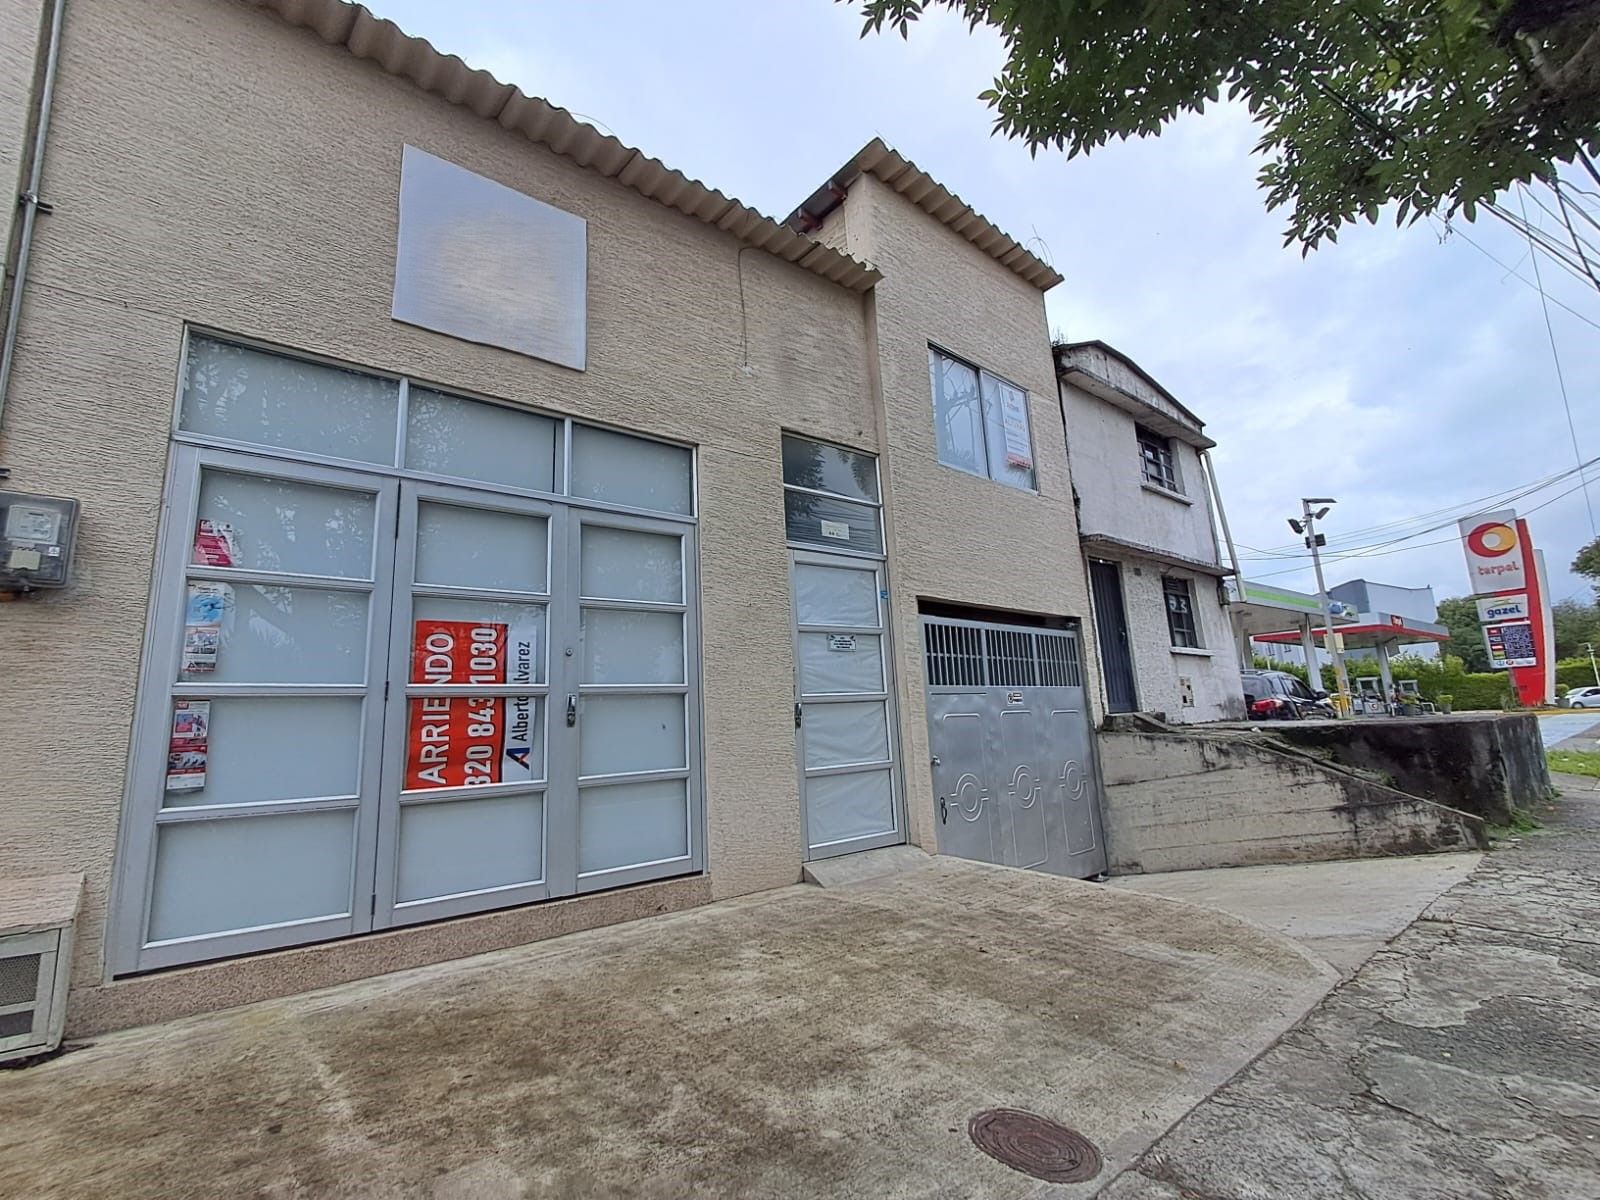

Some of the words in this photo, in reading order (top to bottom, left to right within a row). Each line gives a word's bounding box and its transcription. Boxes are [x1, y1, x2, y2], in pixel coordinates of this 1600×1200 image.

[1487, 604, 1522, 619] gazel
[469, 627, 498, 685] 1030
[513, 641, 531, 686] lvarez
[467, 697, 495, 738] 843
[511, 695, 530, 742] Alberto
[464, 745, 494, 786] 320
